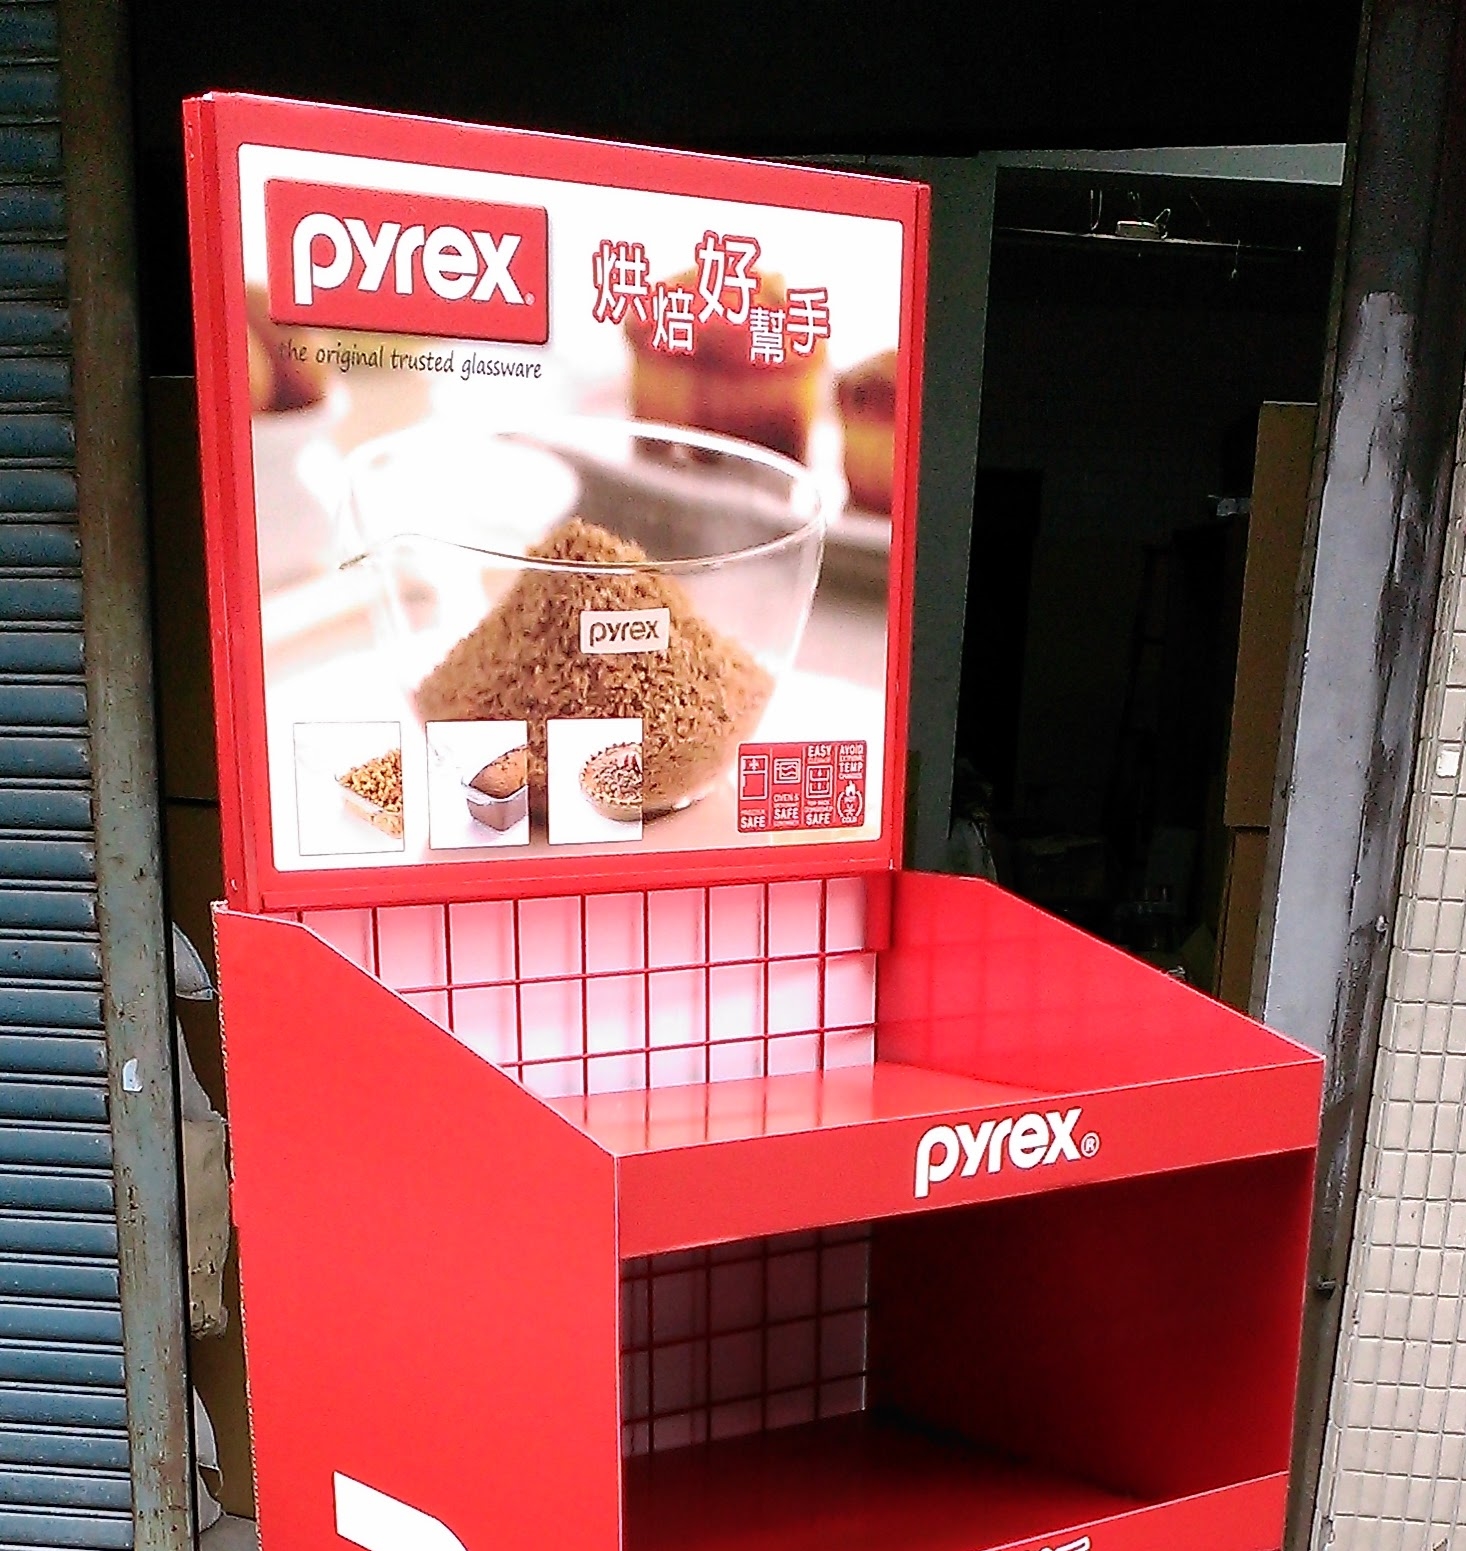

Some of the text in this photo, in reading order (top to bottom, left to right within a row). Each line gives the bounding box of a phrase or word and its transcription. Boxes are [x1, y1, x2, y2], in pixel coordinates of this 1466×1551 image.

[592, 229, 832, 370] 烘焙好幫手
[315, 341, 384, 374] original
[389, 348, 455, 374] trusted
[460, 352, 543, 381] glassware
[589, 619, 660, 647] pyrex
[807, 744, 832, 758] EASY
[774, 807, 799, 821] SAFE
[805, 812, 832, 826] SAFE
[740, 815, 766, 829] SAFE
